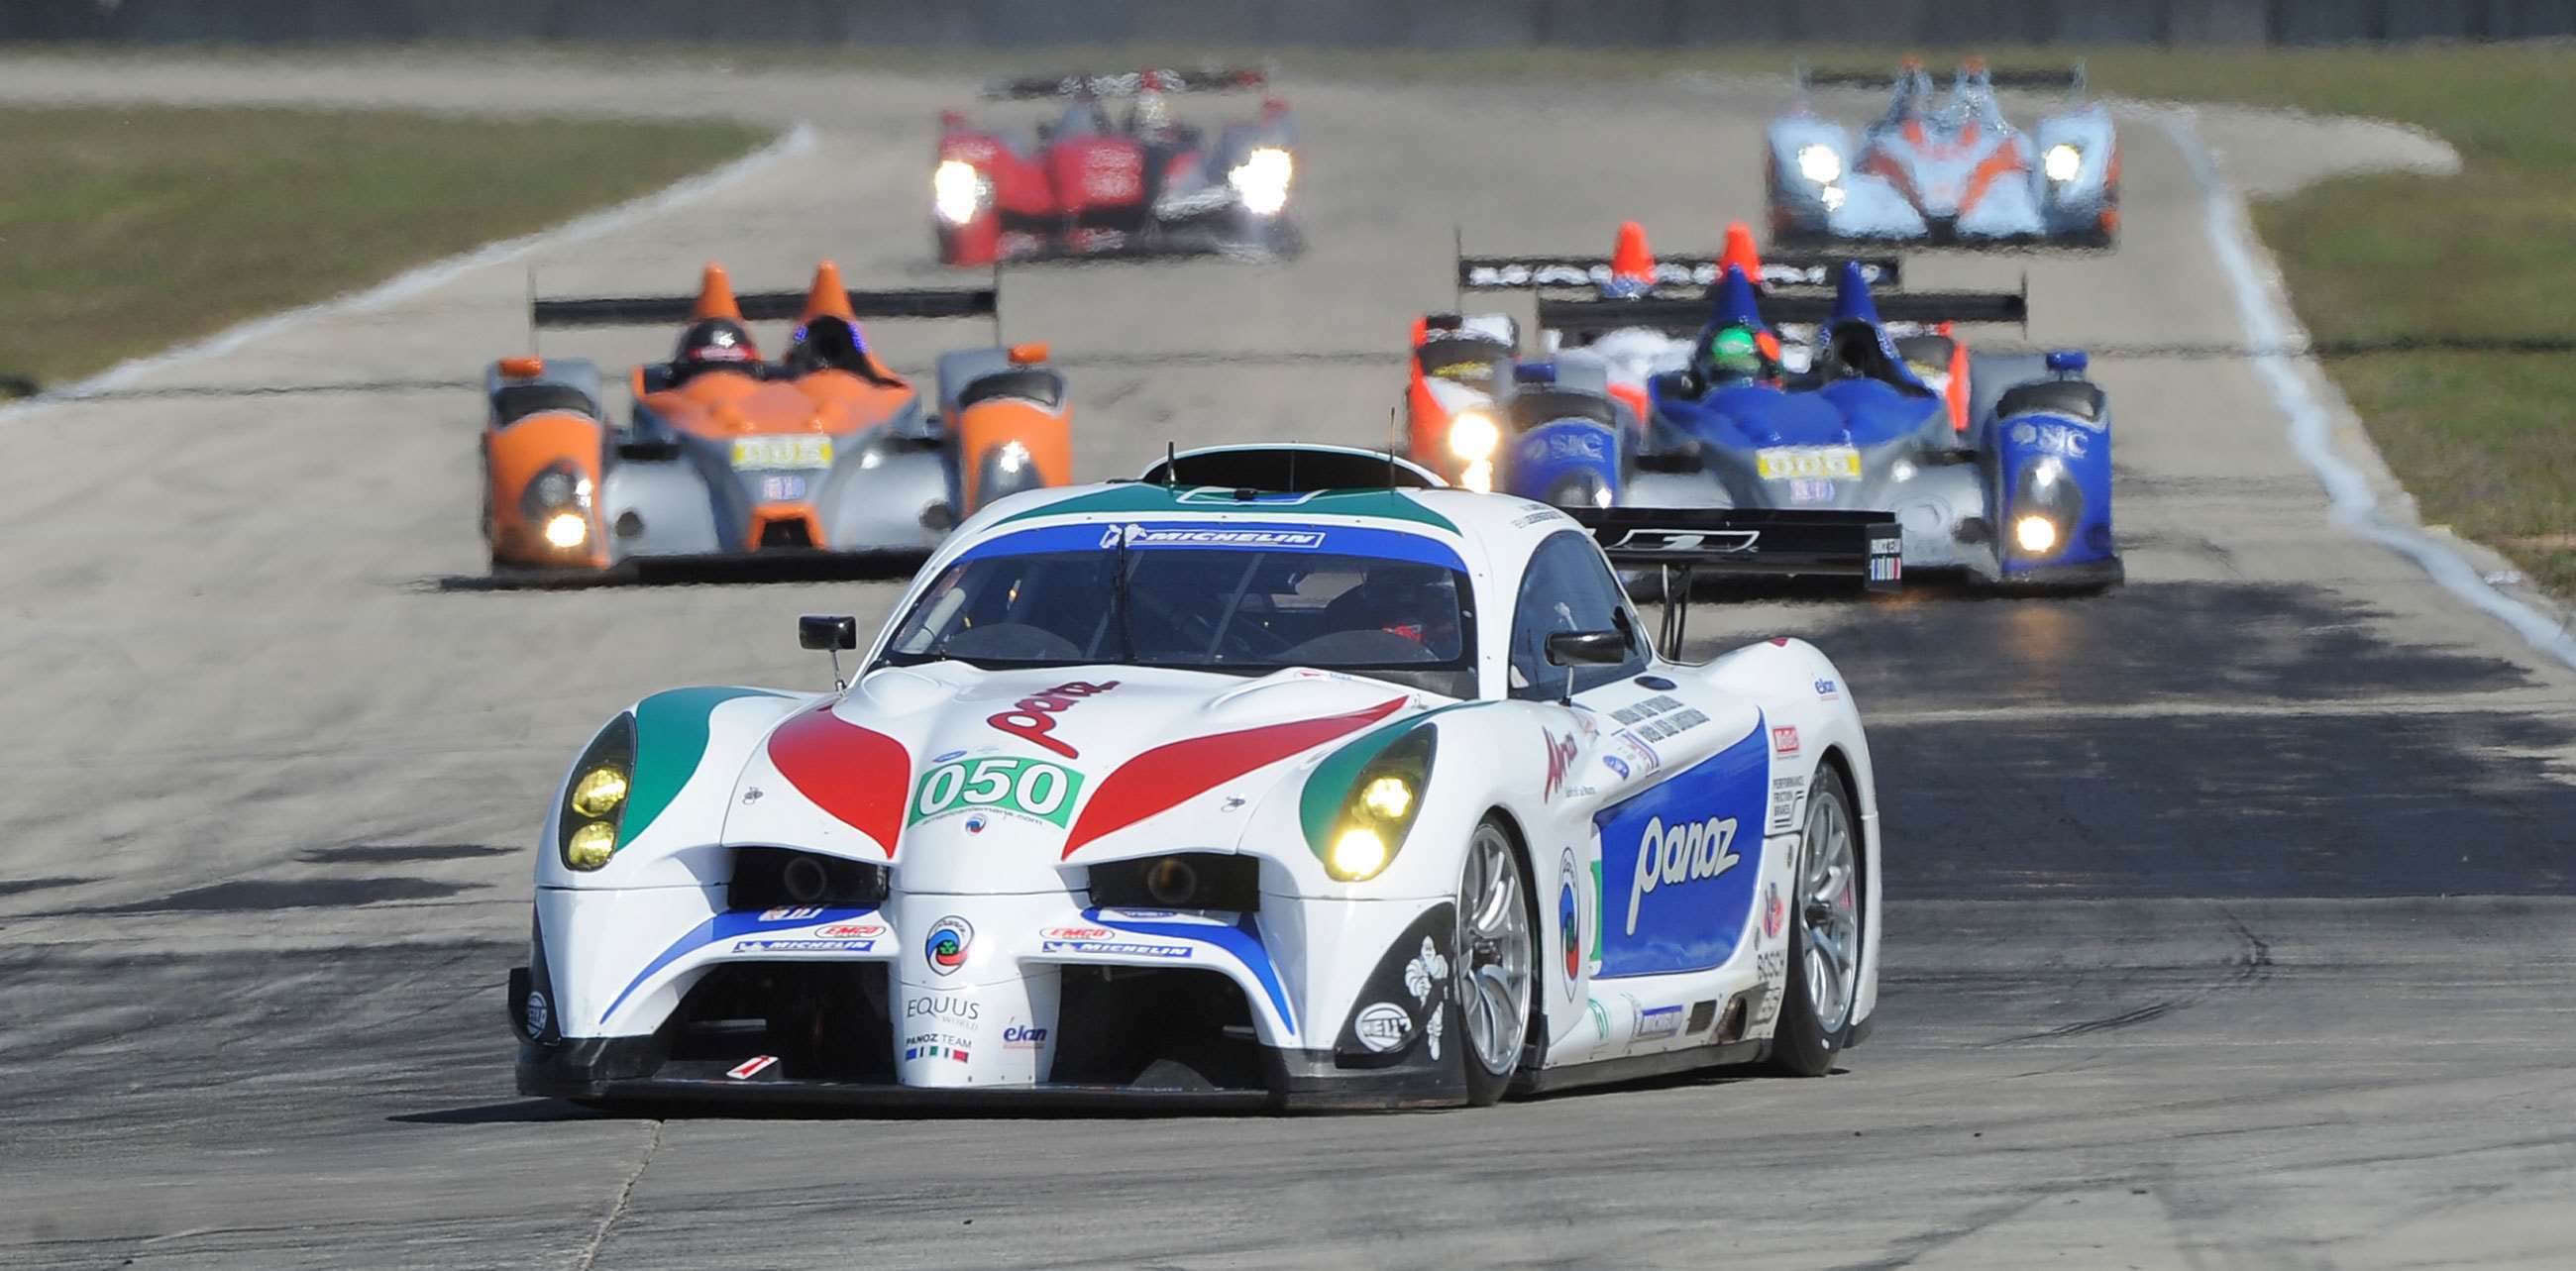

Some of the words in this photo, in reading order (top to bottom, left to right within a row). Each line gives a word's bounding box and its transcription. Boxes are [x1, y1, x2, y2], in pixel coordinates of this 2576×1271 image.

[1144, 531, 1316, 545] MICHELIN
[918, 759, 1069, 816] 050
[1625, 814, 1742, 937] panoz
[769, 941, 871, 950] MICHELIN
[1079, 941, 1188, 956] MICHELIN
[907, 996, 981, 1020] EQUUS
[941, 1034, 973, 1048] TEAM
